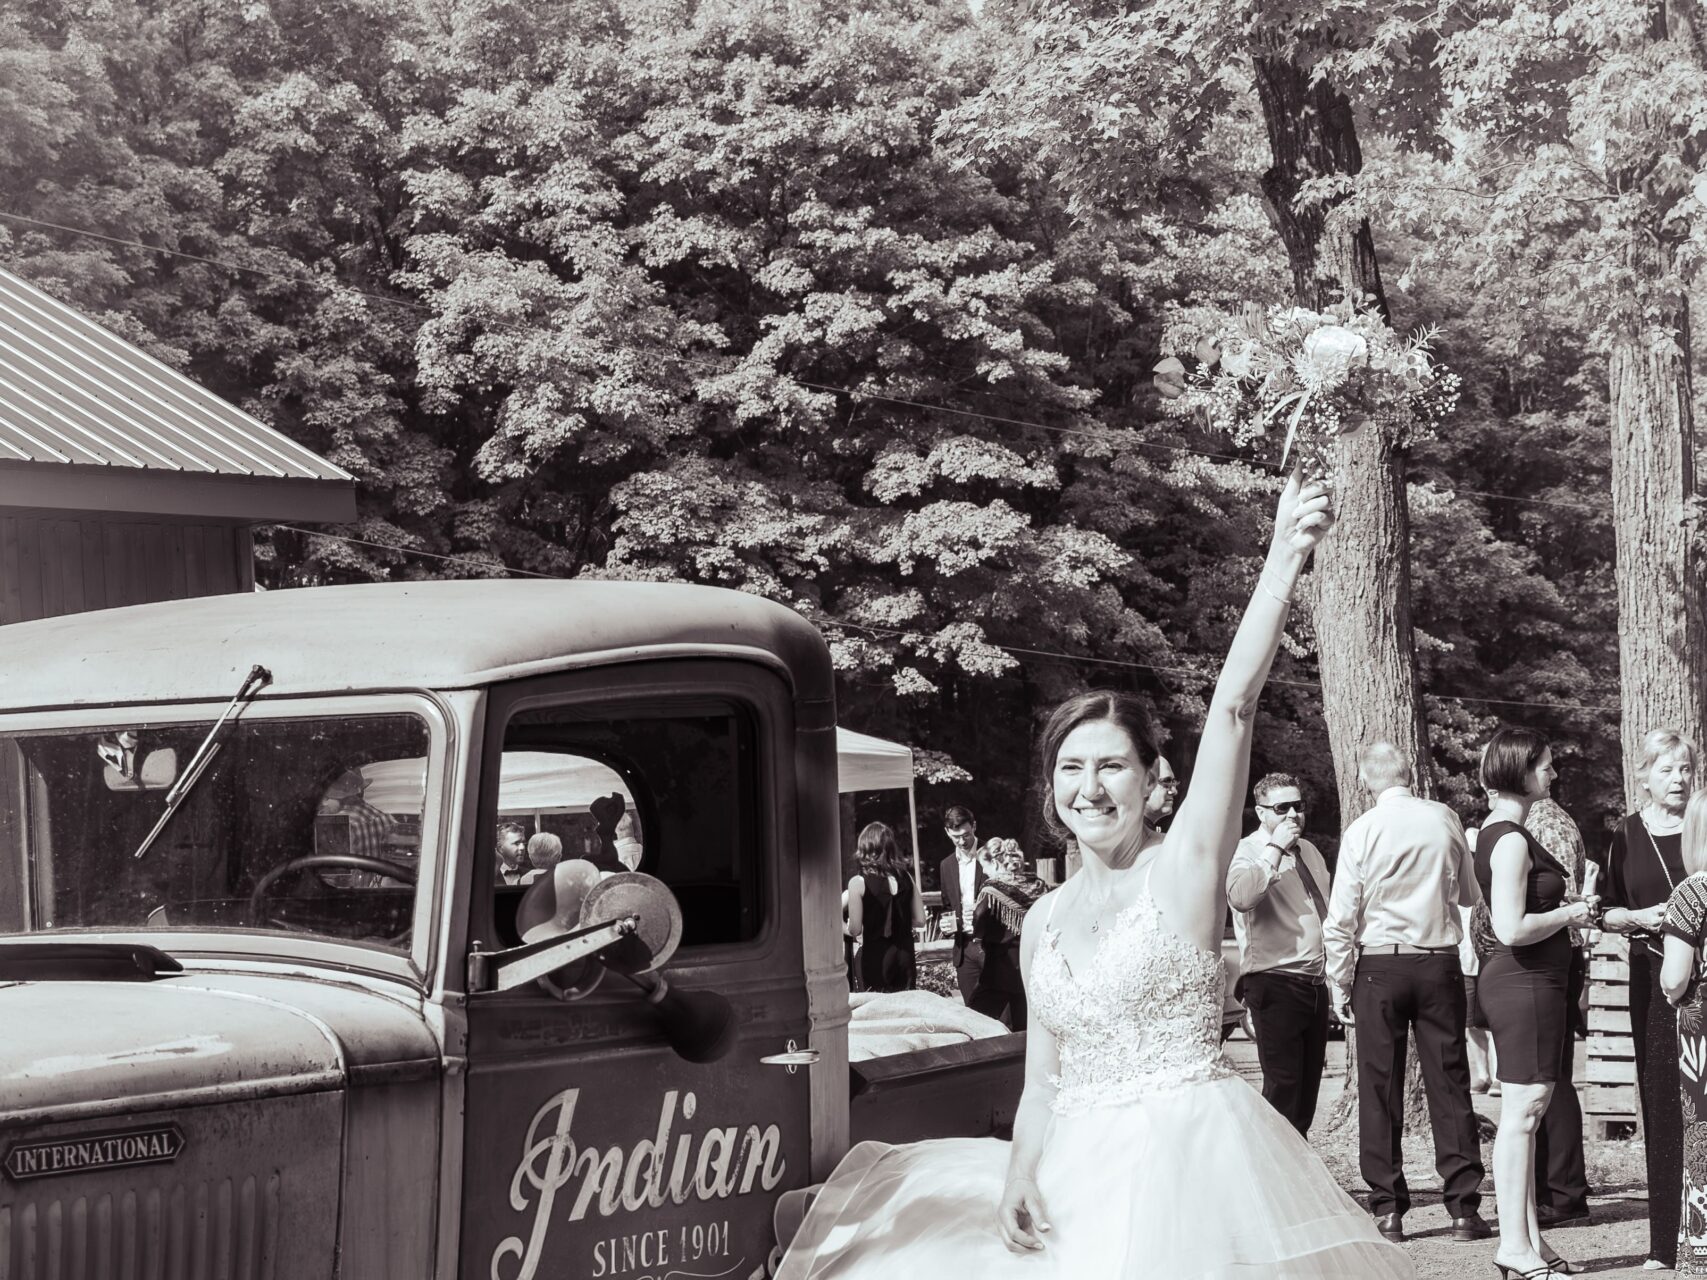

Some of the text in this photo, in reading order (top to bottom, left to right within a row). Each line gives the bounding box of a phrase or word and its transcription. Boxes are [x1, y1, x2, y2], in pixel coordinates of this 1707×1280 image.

[16, 1133, 174, 1173] INTERNATIONAL
[592, 1220, 729, 1278] SINCE 1901
